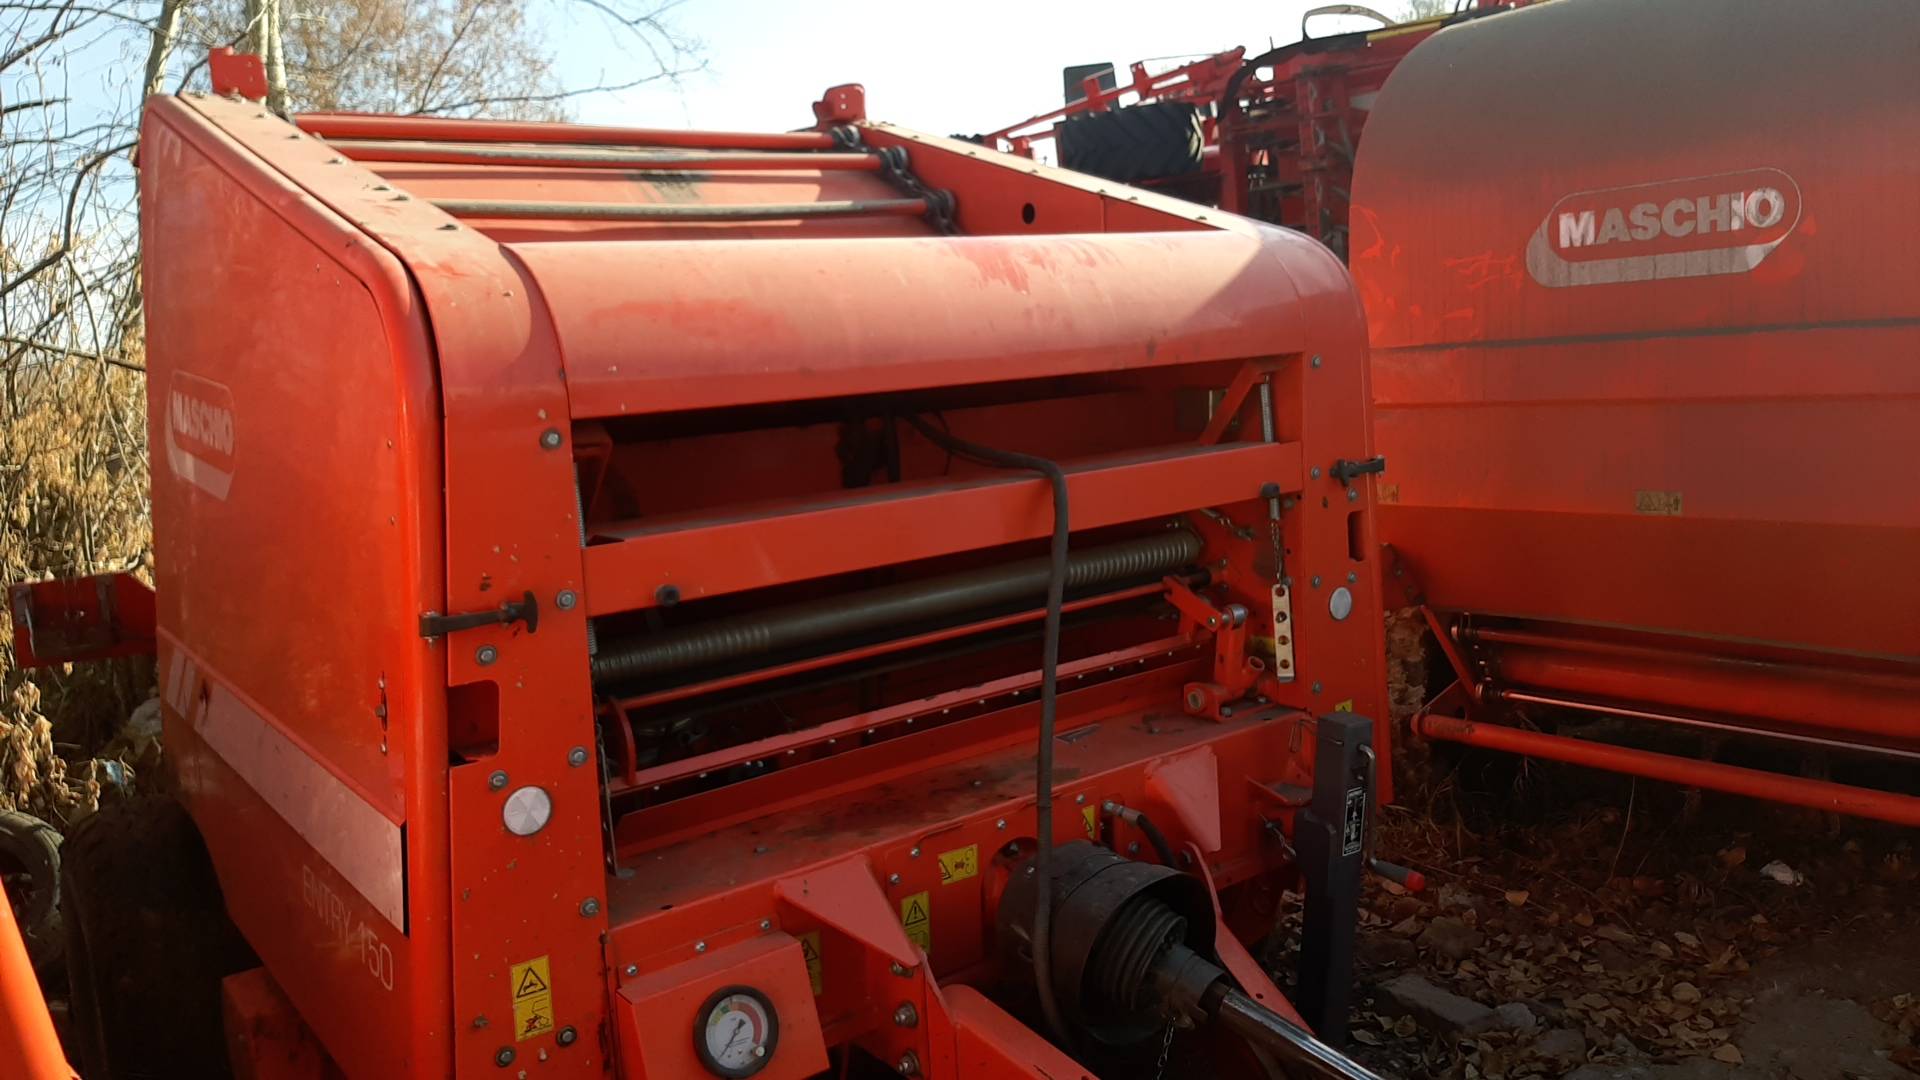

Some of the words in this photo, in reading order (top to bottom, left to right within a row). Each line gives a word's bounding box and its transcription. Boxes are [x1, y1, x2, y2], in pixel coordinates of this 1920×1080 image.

[1558, 186, 1785, 249] MASCHIO
[171, 388, 235, 457] MASCHIO
[303, 863, 352, 945] ENTRY
[358, 920, 394, 992] 150
